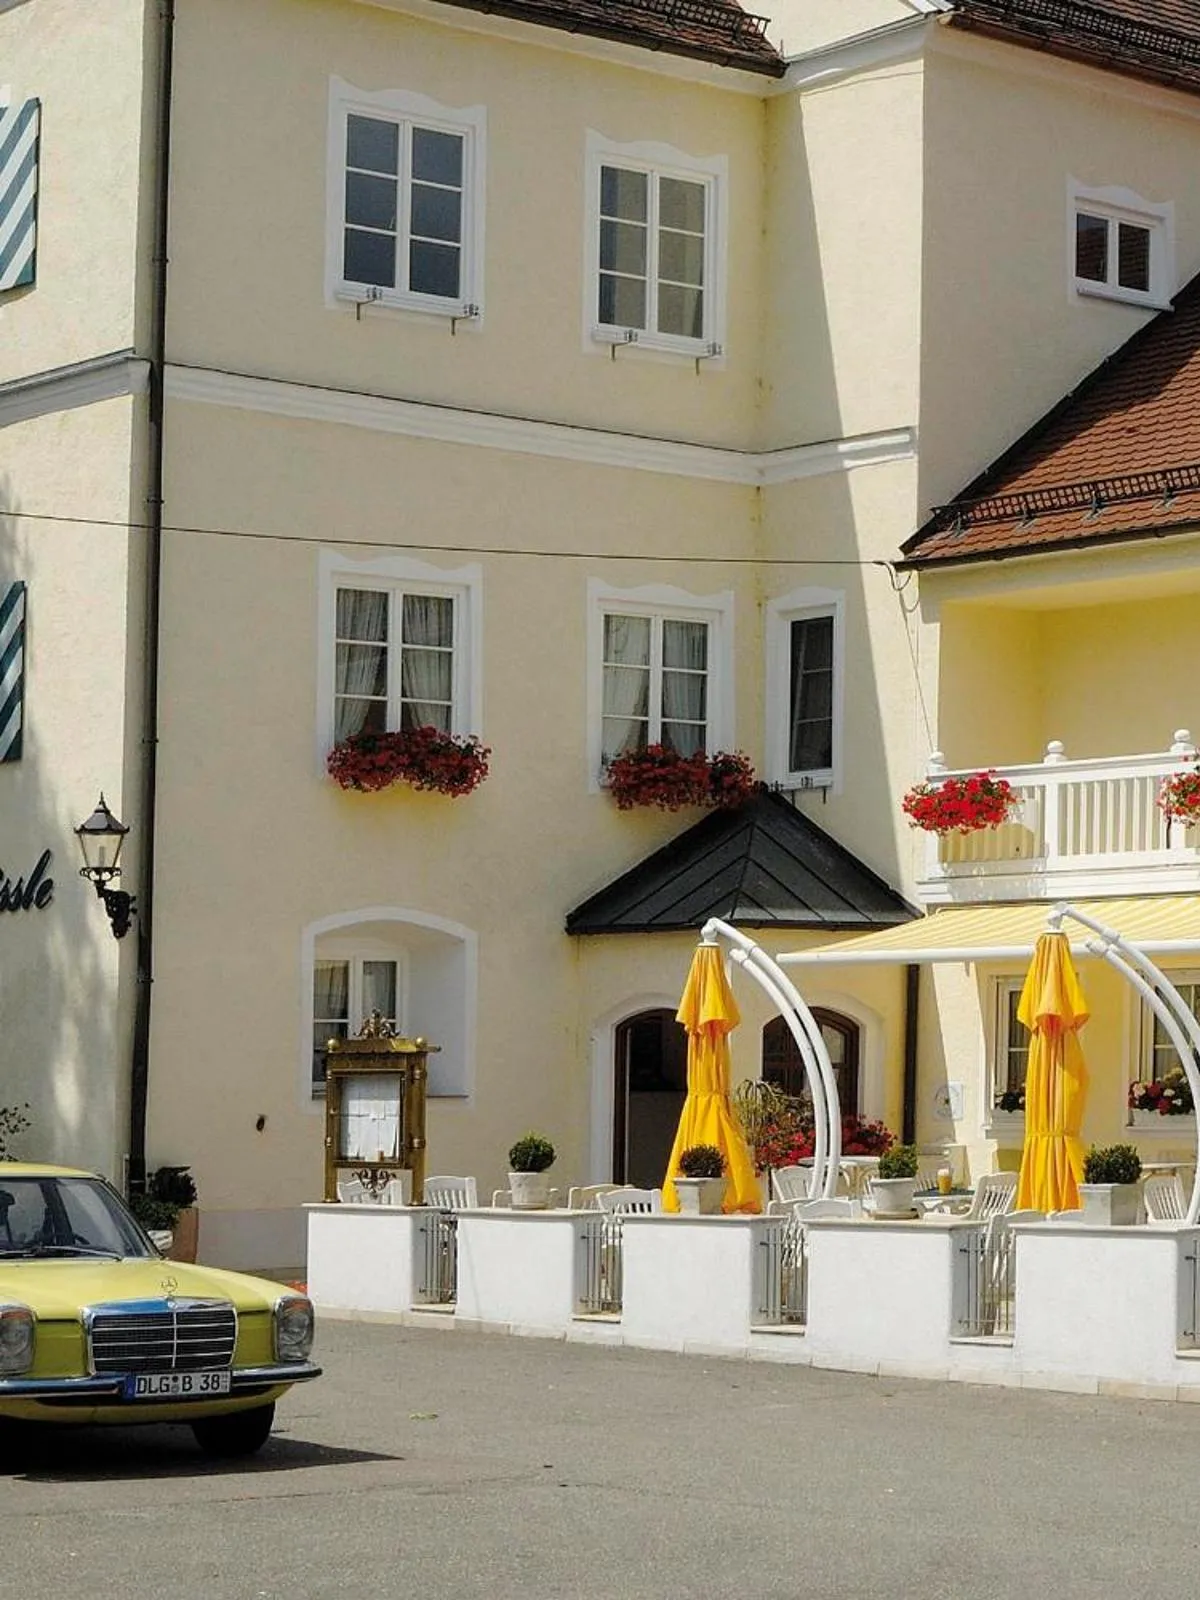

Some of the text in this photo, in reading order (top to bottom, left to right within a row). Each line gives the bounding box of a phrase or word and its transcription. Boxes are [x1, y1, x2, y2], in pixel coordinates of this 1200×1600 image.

[0, 848, 53, 911] ssle
[136, 1376, 170, 1394] DLG
[182, 1375, 193, 1392] B
[200, 1374, 220, 1391] 38
